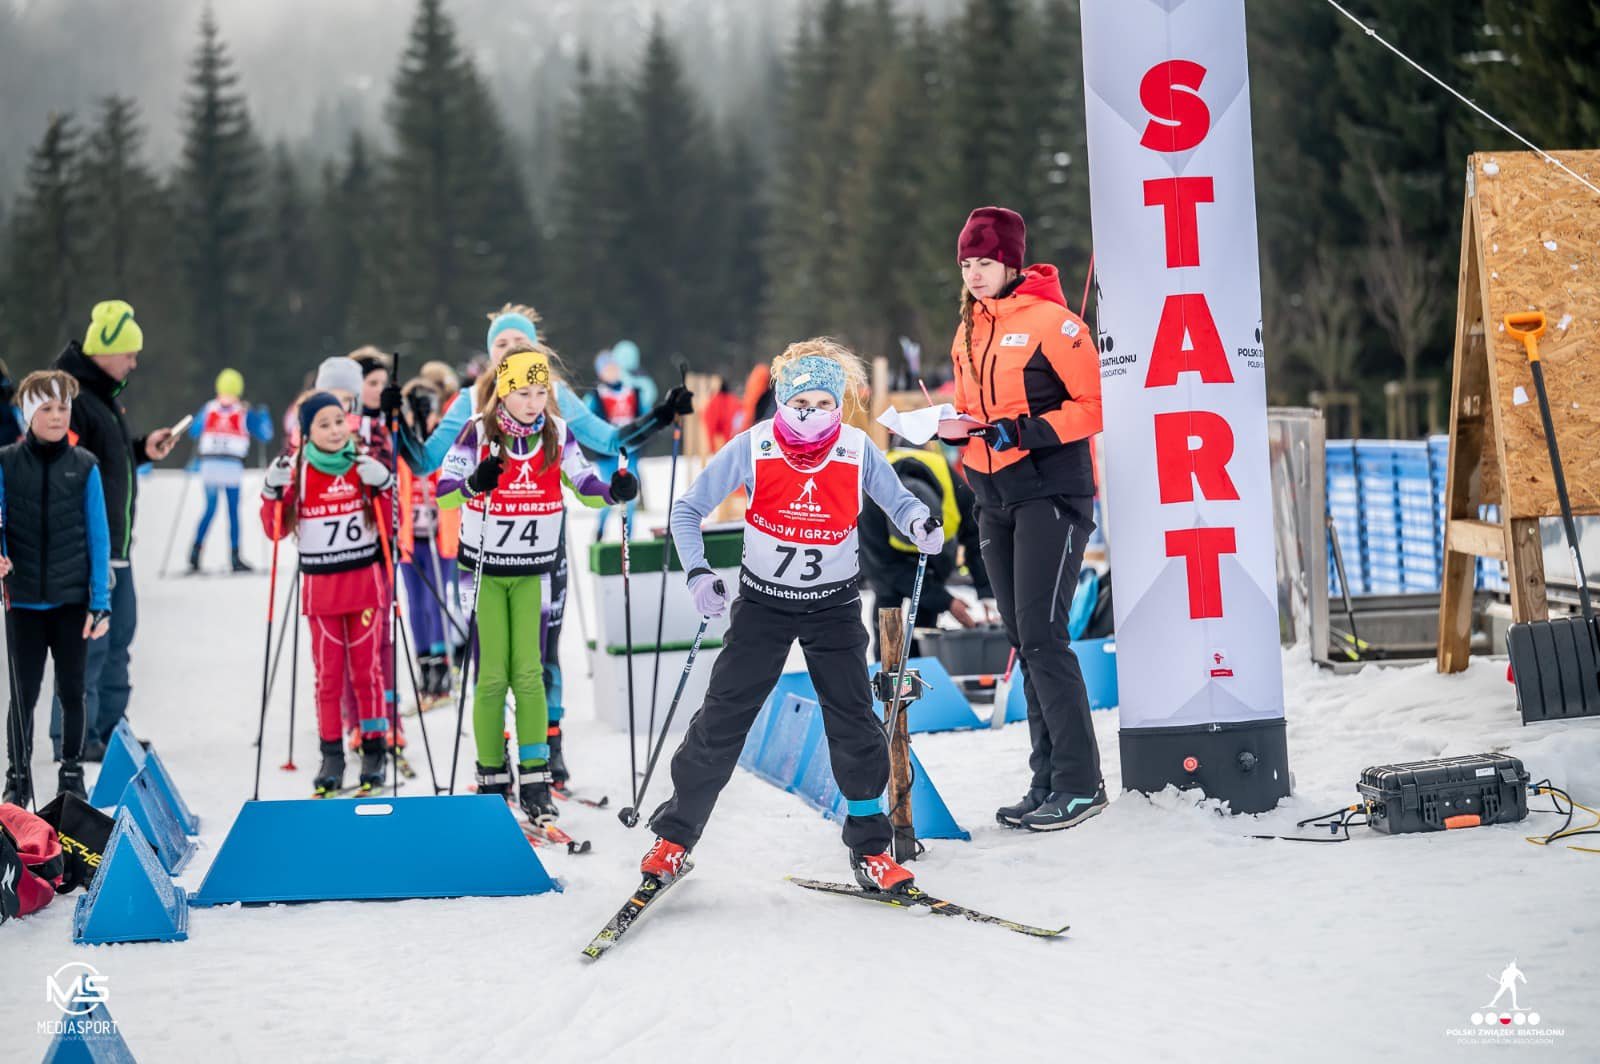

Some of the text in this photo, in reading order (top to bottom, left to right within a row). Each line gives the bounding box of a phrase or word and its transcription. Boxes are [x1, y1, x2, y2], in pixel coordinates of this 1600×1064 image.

[1139, 59, 1240, 620] START
[327, 504, 338, 514] W
[505, 503, 517, 512] W
[323, 515, 362, 546] 76
[496, 520, 539, 547] 74
[753, 513, 785, 535] CELUJ
[785, 526, 796, 537] W
[773, 544, 824, 582] 73
